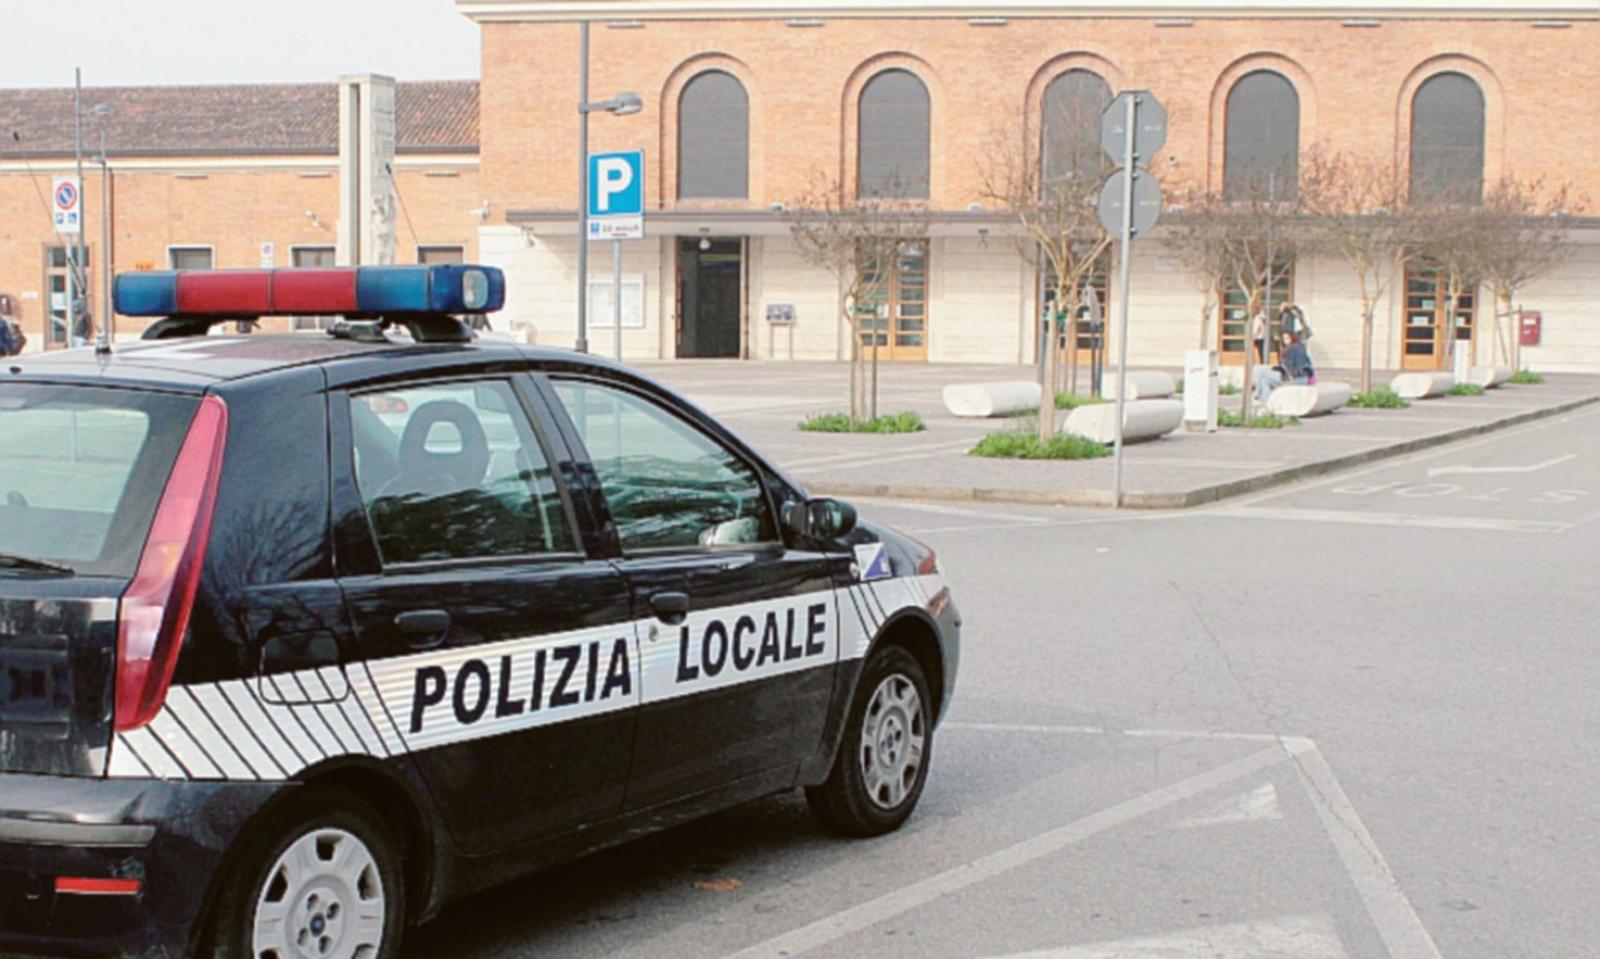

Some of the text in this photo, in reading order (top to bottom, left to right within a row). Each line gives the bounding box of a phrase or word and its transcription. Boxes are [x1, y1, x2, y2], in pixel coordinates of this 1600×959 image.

[598, 157, 633, 211] P
[410, 603, 826, 733] POLIZIA LOCALE
